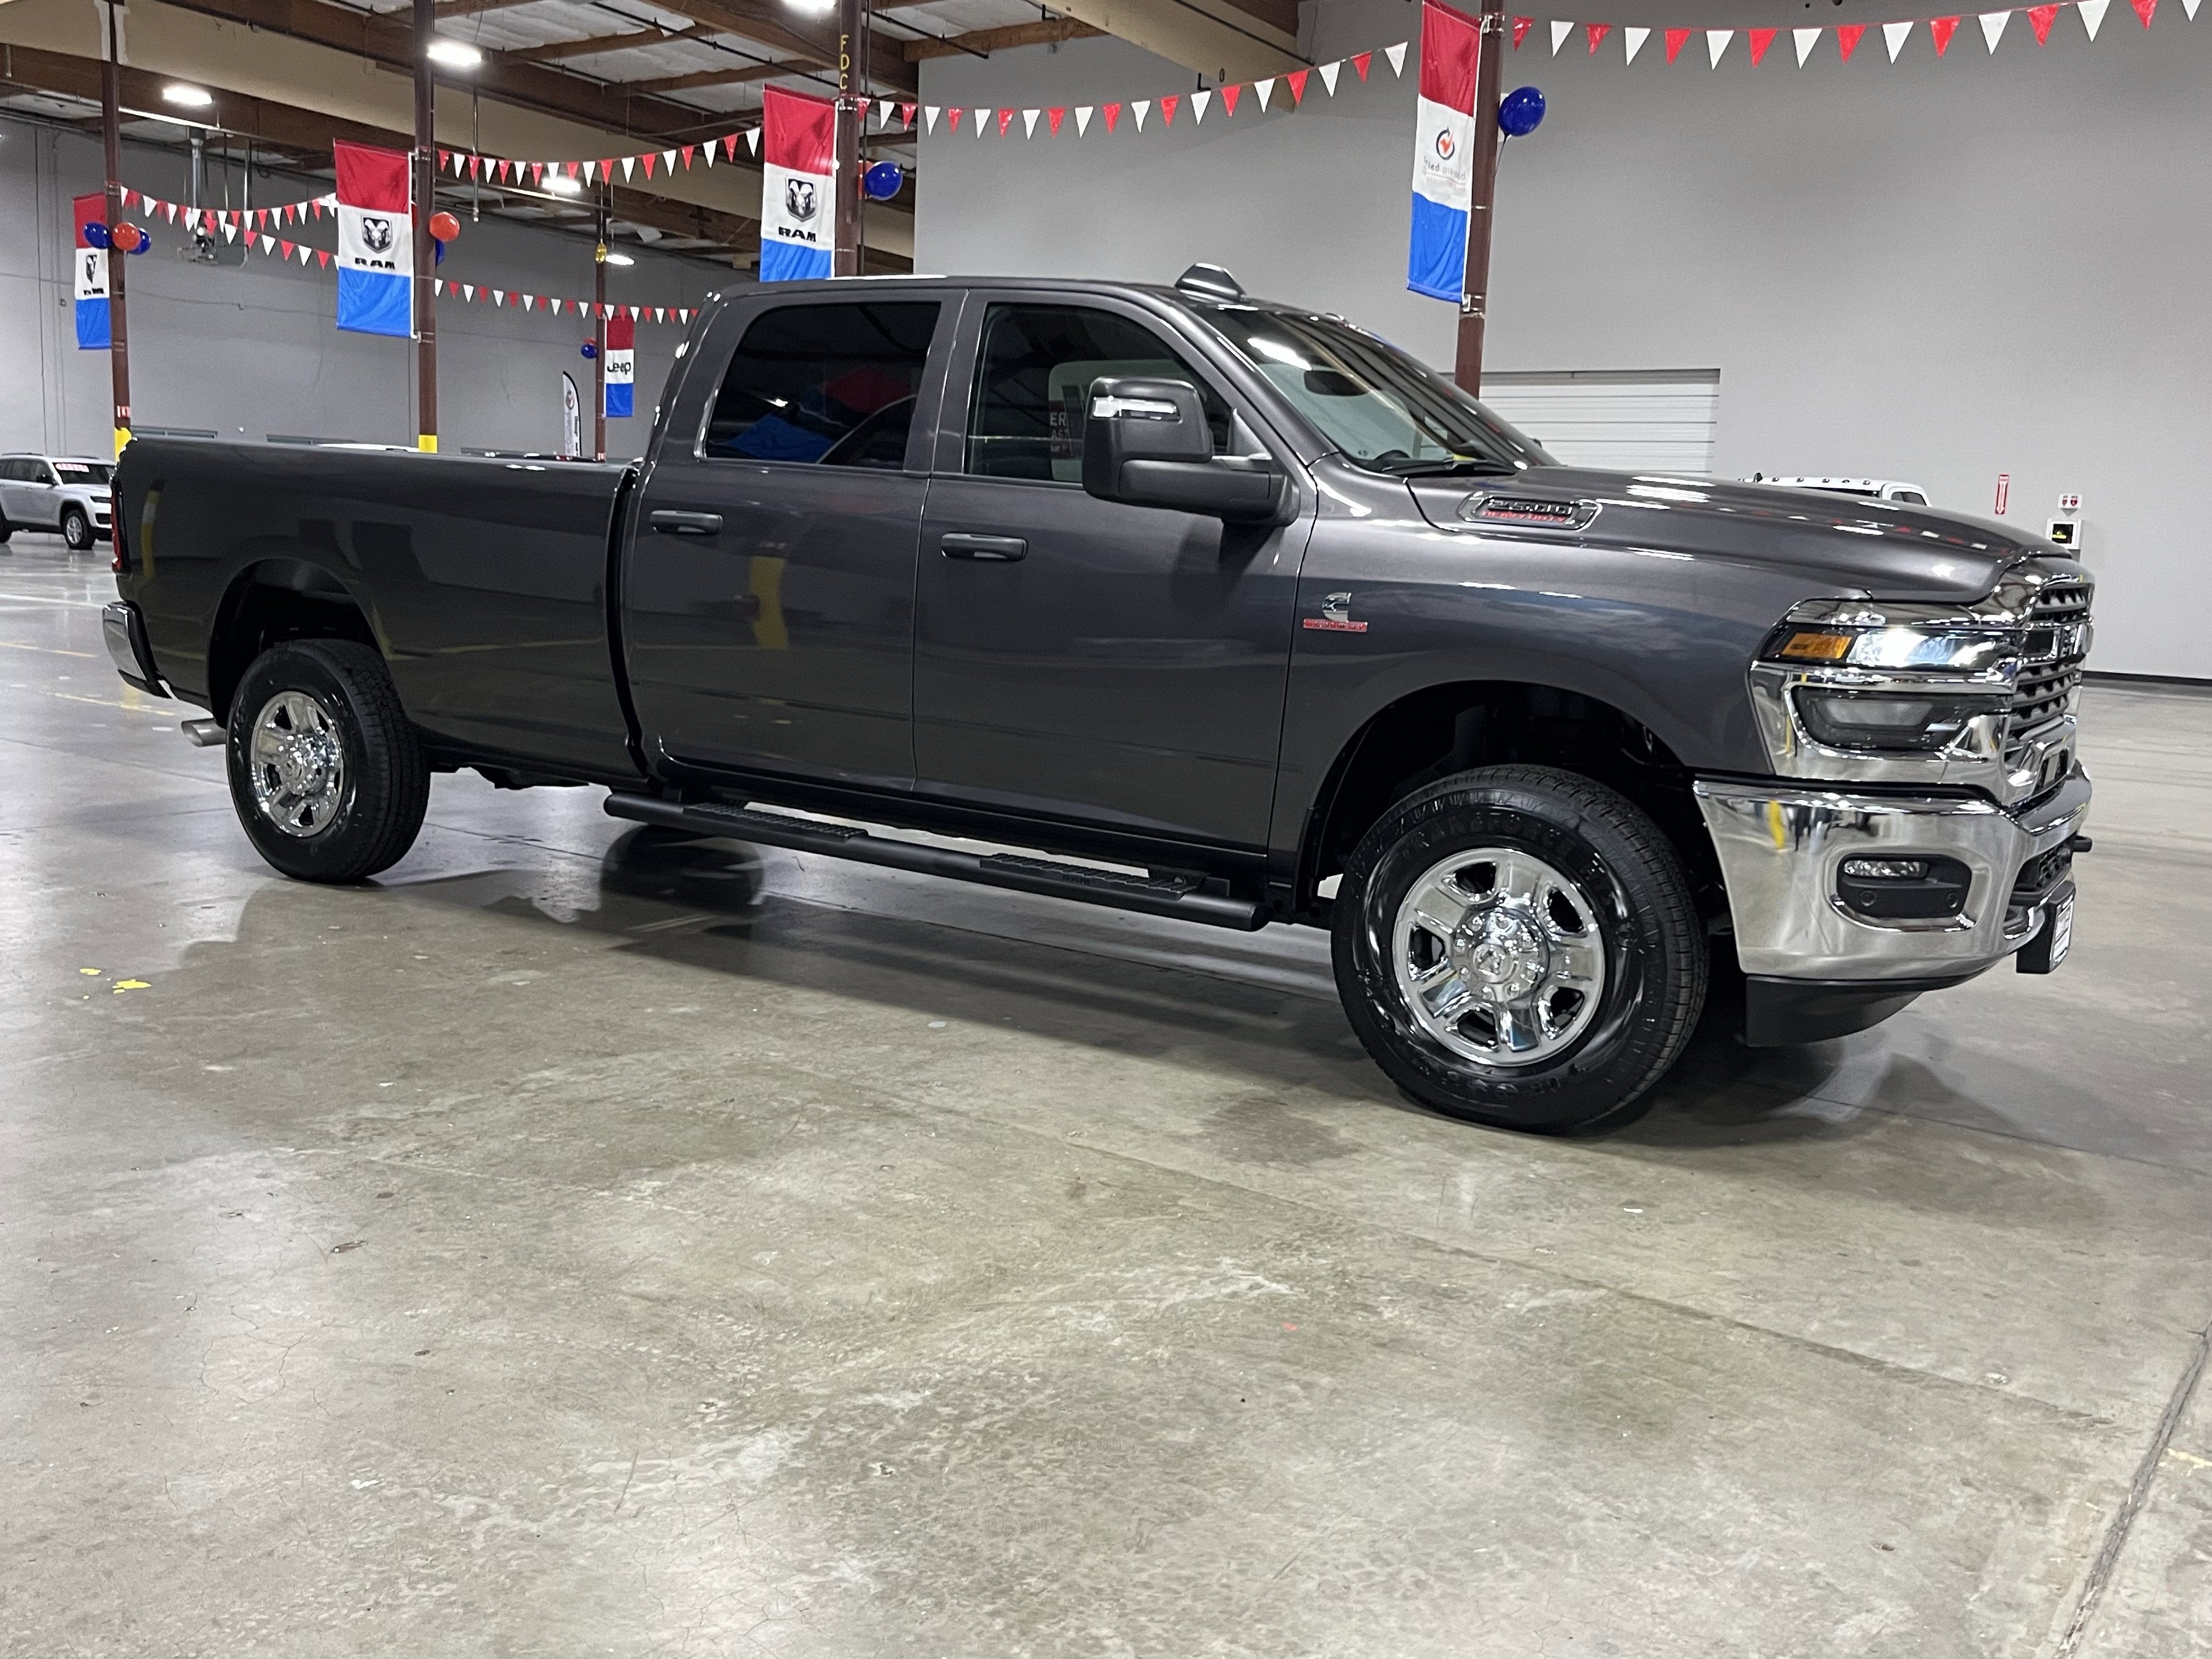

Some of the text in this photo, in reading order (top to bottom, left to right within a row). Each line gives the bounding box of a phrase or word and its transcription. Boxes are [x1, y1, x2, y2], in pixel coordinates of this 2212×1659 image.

[778, 225, 816, 242] RAM
[354, 257, 396, 270] RAM
[607, 362, 631, 375] Jeep
[1487, 499, 1573, 515] 2500
